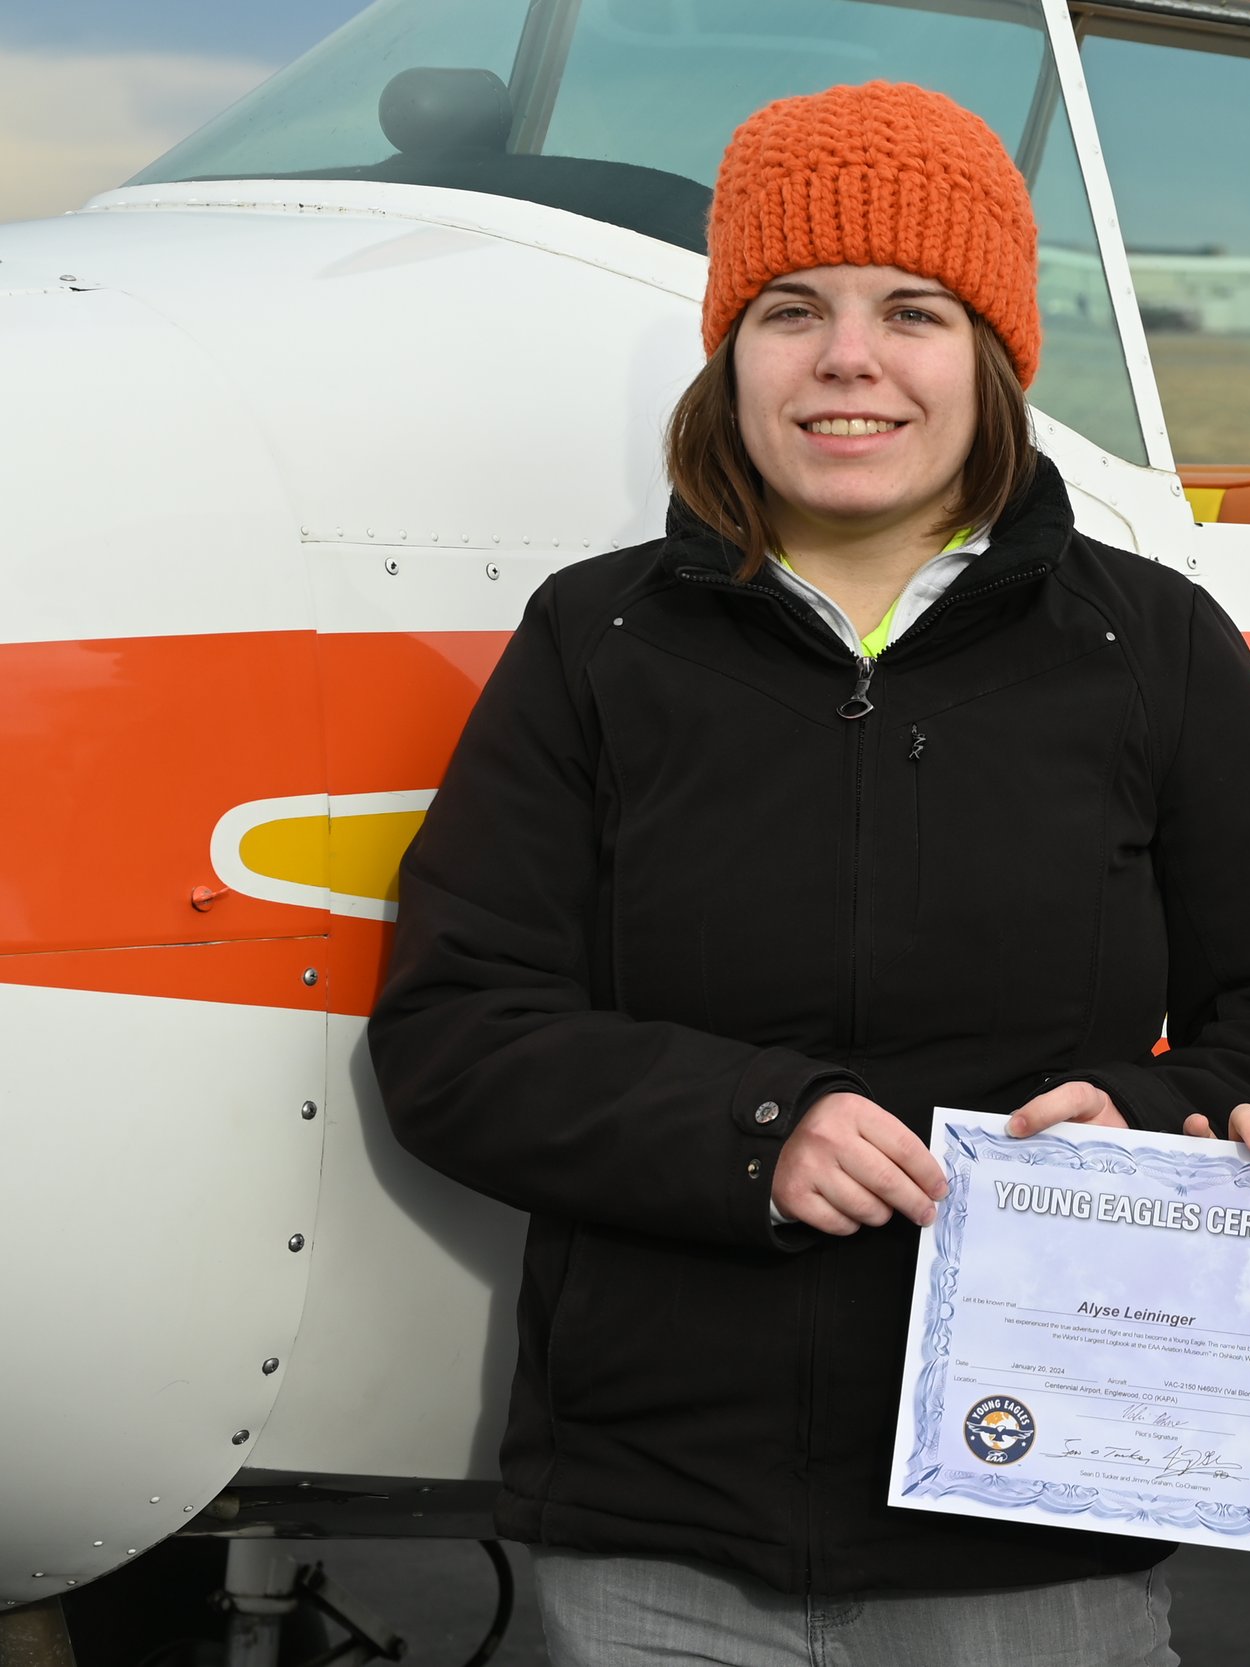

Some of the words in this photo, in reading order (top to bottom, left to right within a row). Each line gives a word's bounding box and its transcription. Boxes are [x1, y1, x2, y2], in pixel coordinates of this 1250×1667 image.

[993, 1179, 1093, 1217] YOUNG
[1096, 1192, 1202, 1234] EAGLES
[1077, 1301, 1120, 1318] Alyse
[1124, 1306, 1196, 1327] Leininger
[1015, 1318, 1049, 1328] experienced
[1072, 1325, 1099, 1333] adventure
[1084, 1336, 1104, 1344] Largest
[1105, 1339, 1129, 1347] Logbook
[1161, 1345, 1182, 1353] Aviation
[1010, 1362, 1036, 1371] January
[953, 1375, 977, 1383] Location
[1044, 1381, 1078, 1391] Centennial
[1141, 1393, 1153, 1401] CO
[1154, 1394, 1178, 1404] (KAPA)
[1107, 1377, 1127, 1385] Aircraft
[1163, 1380, 1196, 1390] VAC-2150
[1197, 1384, 1222, 1393] N4603V
[1223, 1388, 1236, 1396] (Val
[972, 1399, 1001, 1420] YOUNG
[1003, 1400, 1030, 1426] EAGLES
[1152, 1432, 1178, 1442] Signature
[985, 1455, 1004, 1463] EAA
[1102, 1472, 1119, 1480] Tucker
[1131, 1476, 1150, 1484] Jimmy
